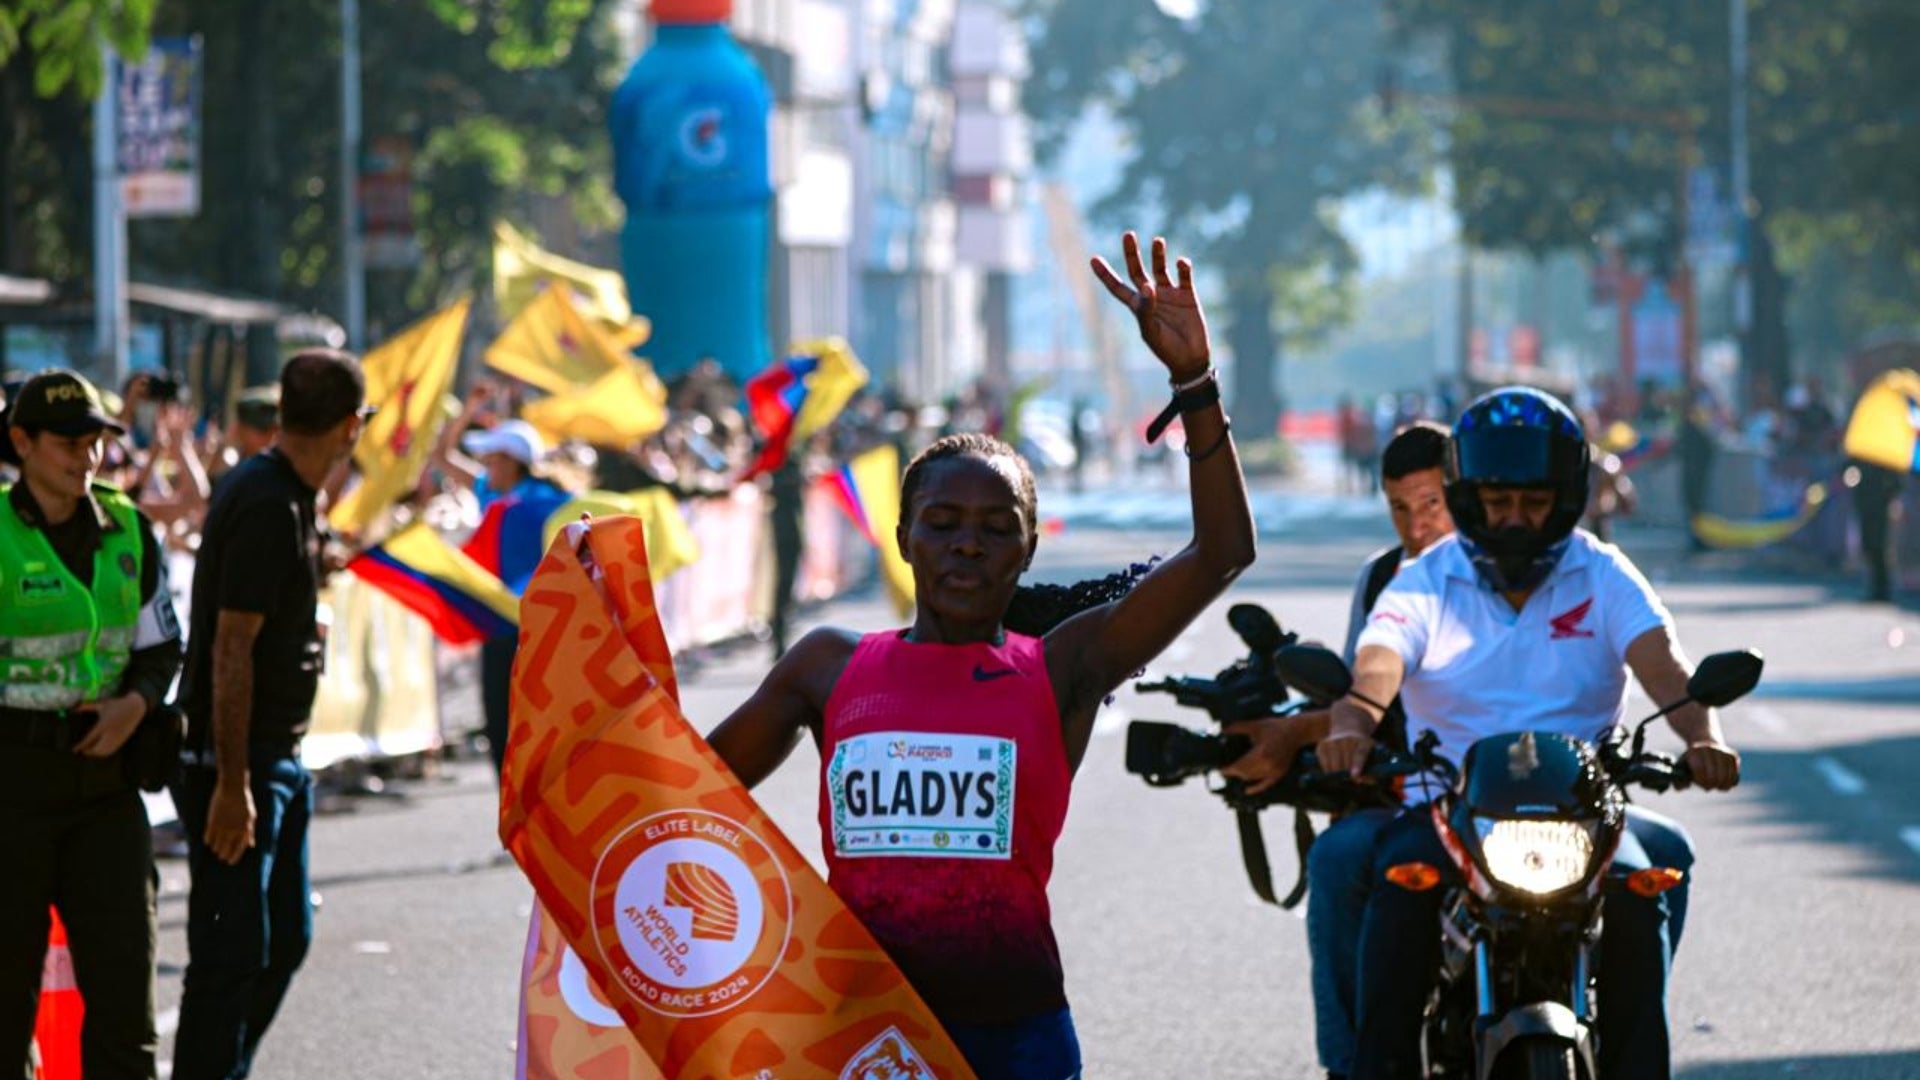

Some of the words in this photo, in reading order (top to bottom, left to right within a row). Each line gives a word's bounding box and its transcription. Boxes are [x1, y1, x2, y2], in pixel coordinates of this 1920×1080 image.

[845, 769, 997, 819] GLADYS
[644, 819, 691, 840] ELITE
[693, 820, 742, 848] LABEL
[624, 906, 688, 978] ATHLETICS
[645, 904, 690, 957] WORLD
[621, 966, 659, 1001] ROAD
[660, 992, 705, 1008] RACE
[708, 975, 750, 1004] 2024
